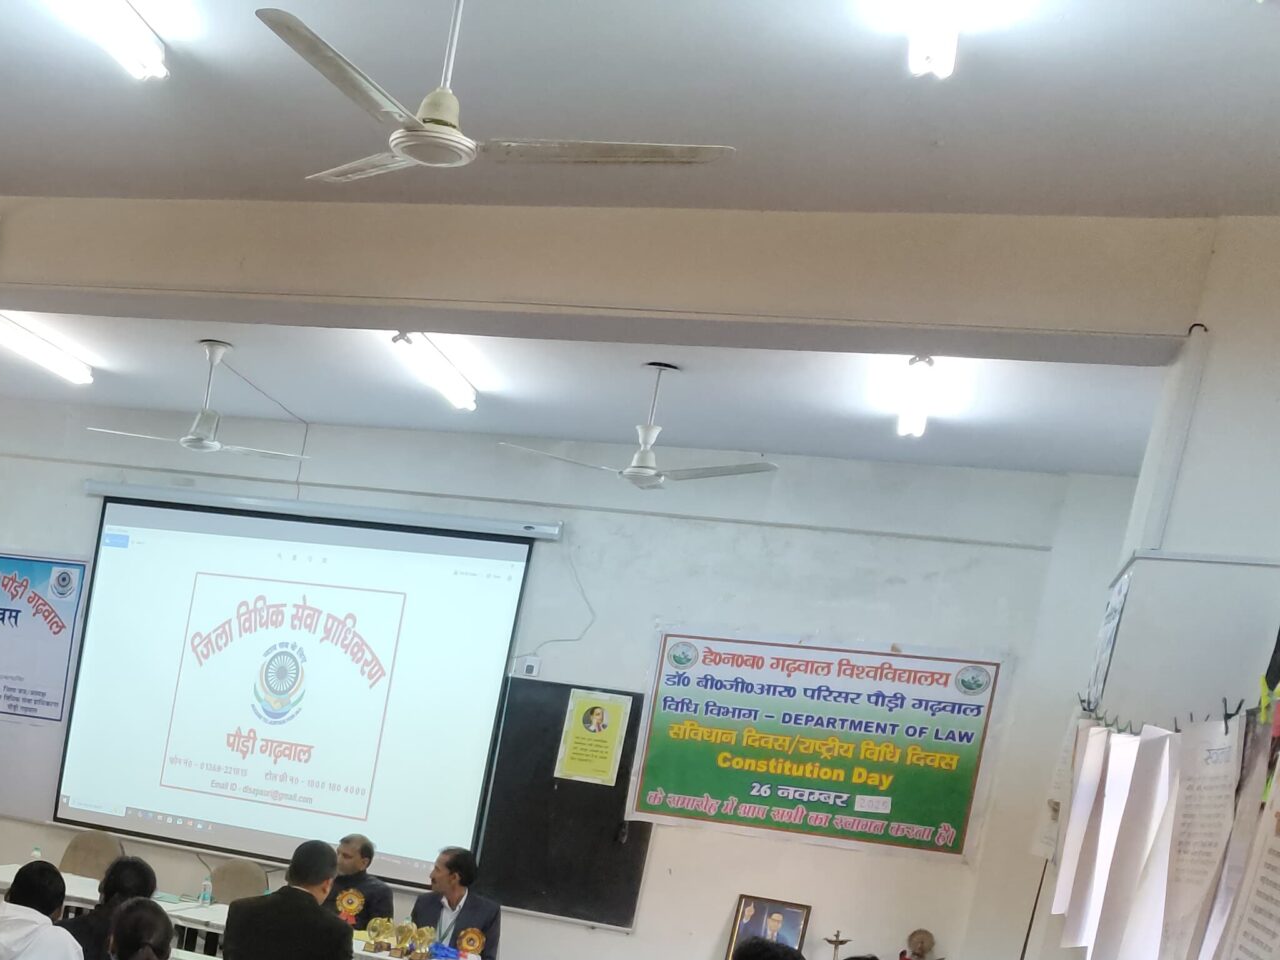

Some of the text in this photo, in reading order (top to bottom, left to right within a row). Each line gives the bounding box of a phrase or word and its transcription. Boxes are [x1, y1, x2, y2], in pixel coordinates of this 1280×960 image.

[27, 591, 66, 635] गढ़वाल
[190, 618, 234, 667] जिला
[236, 595, 287, 638] विधिक
[290, 594, 323, 634] सेवा
[319, 612, 387, 689] प्राधिकरण
[770, 657, 834, 678] गढ़वाल
[837, 658, 952, 688] विश्वविद्यालय
[662, 695, 699, 714] विधि
[704, 701, 759, 721] विभाग
[781, 713, 900, 736] DEPARTMENT
[905, 725, 929, 738] OF
[934, 728, 975, 744] LAW
[803, 685, 862, 705] परिसर
[867, 690, 906, 713] पौड़ी
[911, 698, 984, 717] गढ़वाल
[226, 726, 314, 765] पौड़ी गढ़वाल
[669, 720, 737, 745] संविधान
[860, 740, 901, 764] विधि
[906, 745, 960, 770] दिवस
[717, 752, 894, 791] Constitution Day
[647, 787, 665, 806] के
[666, 794, 721, 816] समारोह
[738, 803, 770, 819] आप
[771, 804, 807, 825] सभी
[807, 811, 832, 828] का
[832, 814, 889, 835] स्वागत
[888, 822, 936, 842] करता
[750, 782, 771, 797] 26
[777, 785, 851, 807] नवम्बर
